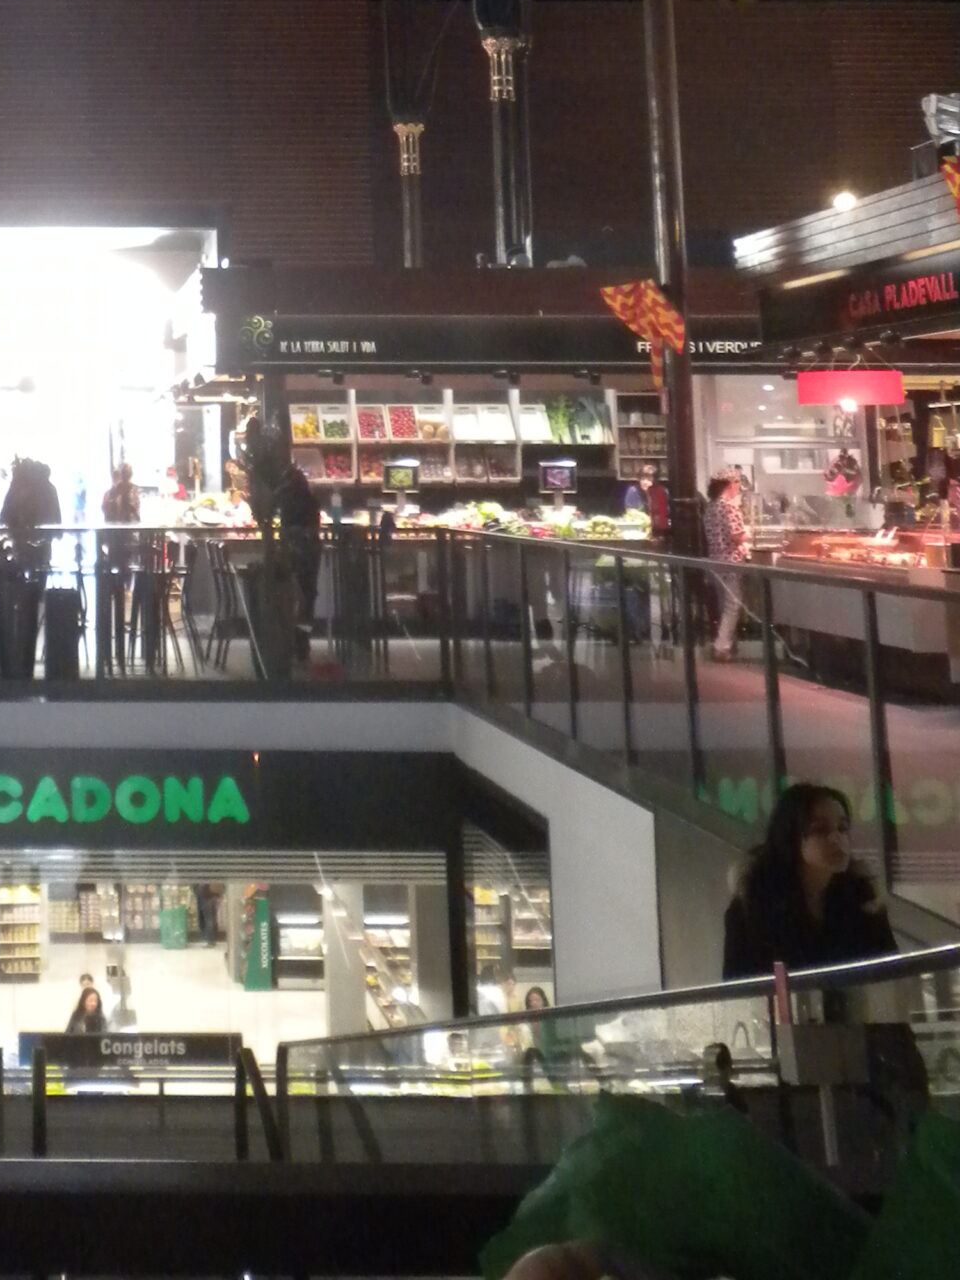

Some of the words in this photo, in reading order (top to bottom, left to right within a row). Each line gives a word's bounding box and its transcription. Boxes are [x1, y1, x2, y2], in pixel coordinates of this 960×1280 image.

[848, 290, 881, 317] CASA
[884, 272, 959, 311] PLADEVALL
[291, 341, 301, 353] LA
[100, 1038, 187, 1059] Congelats
